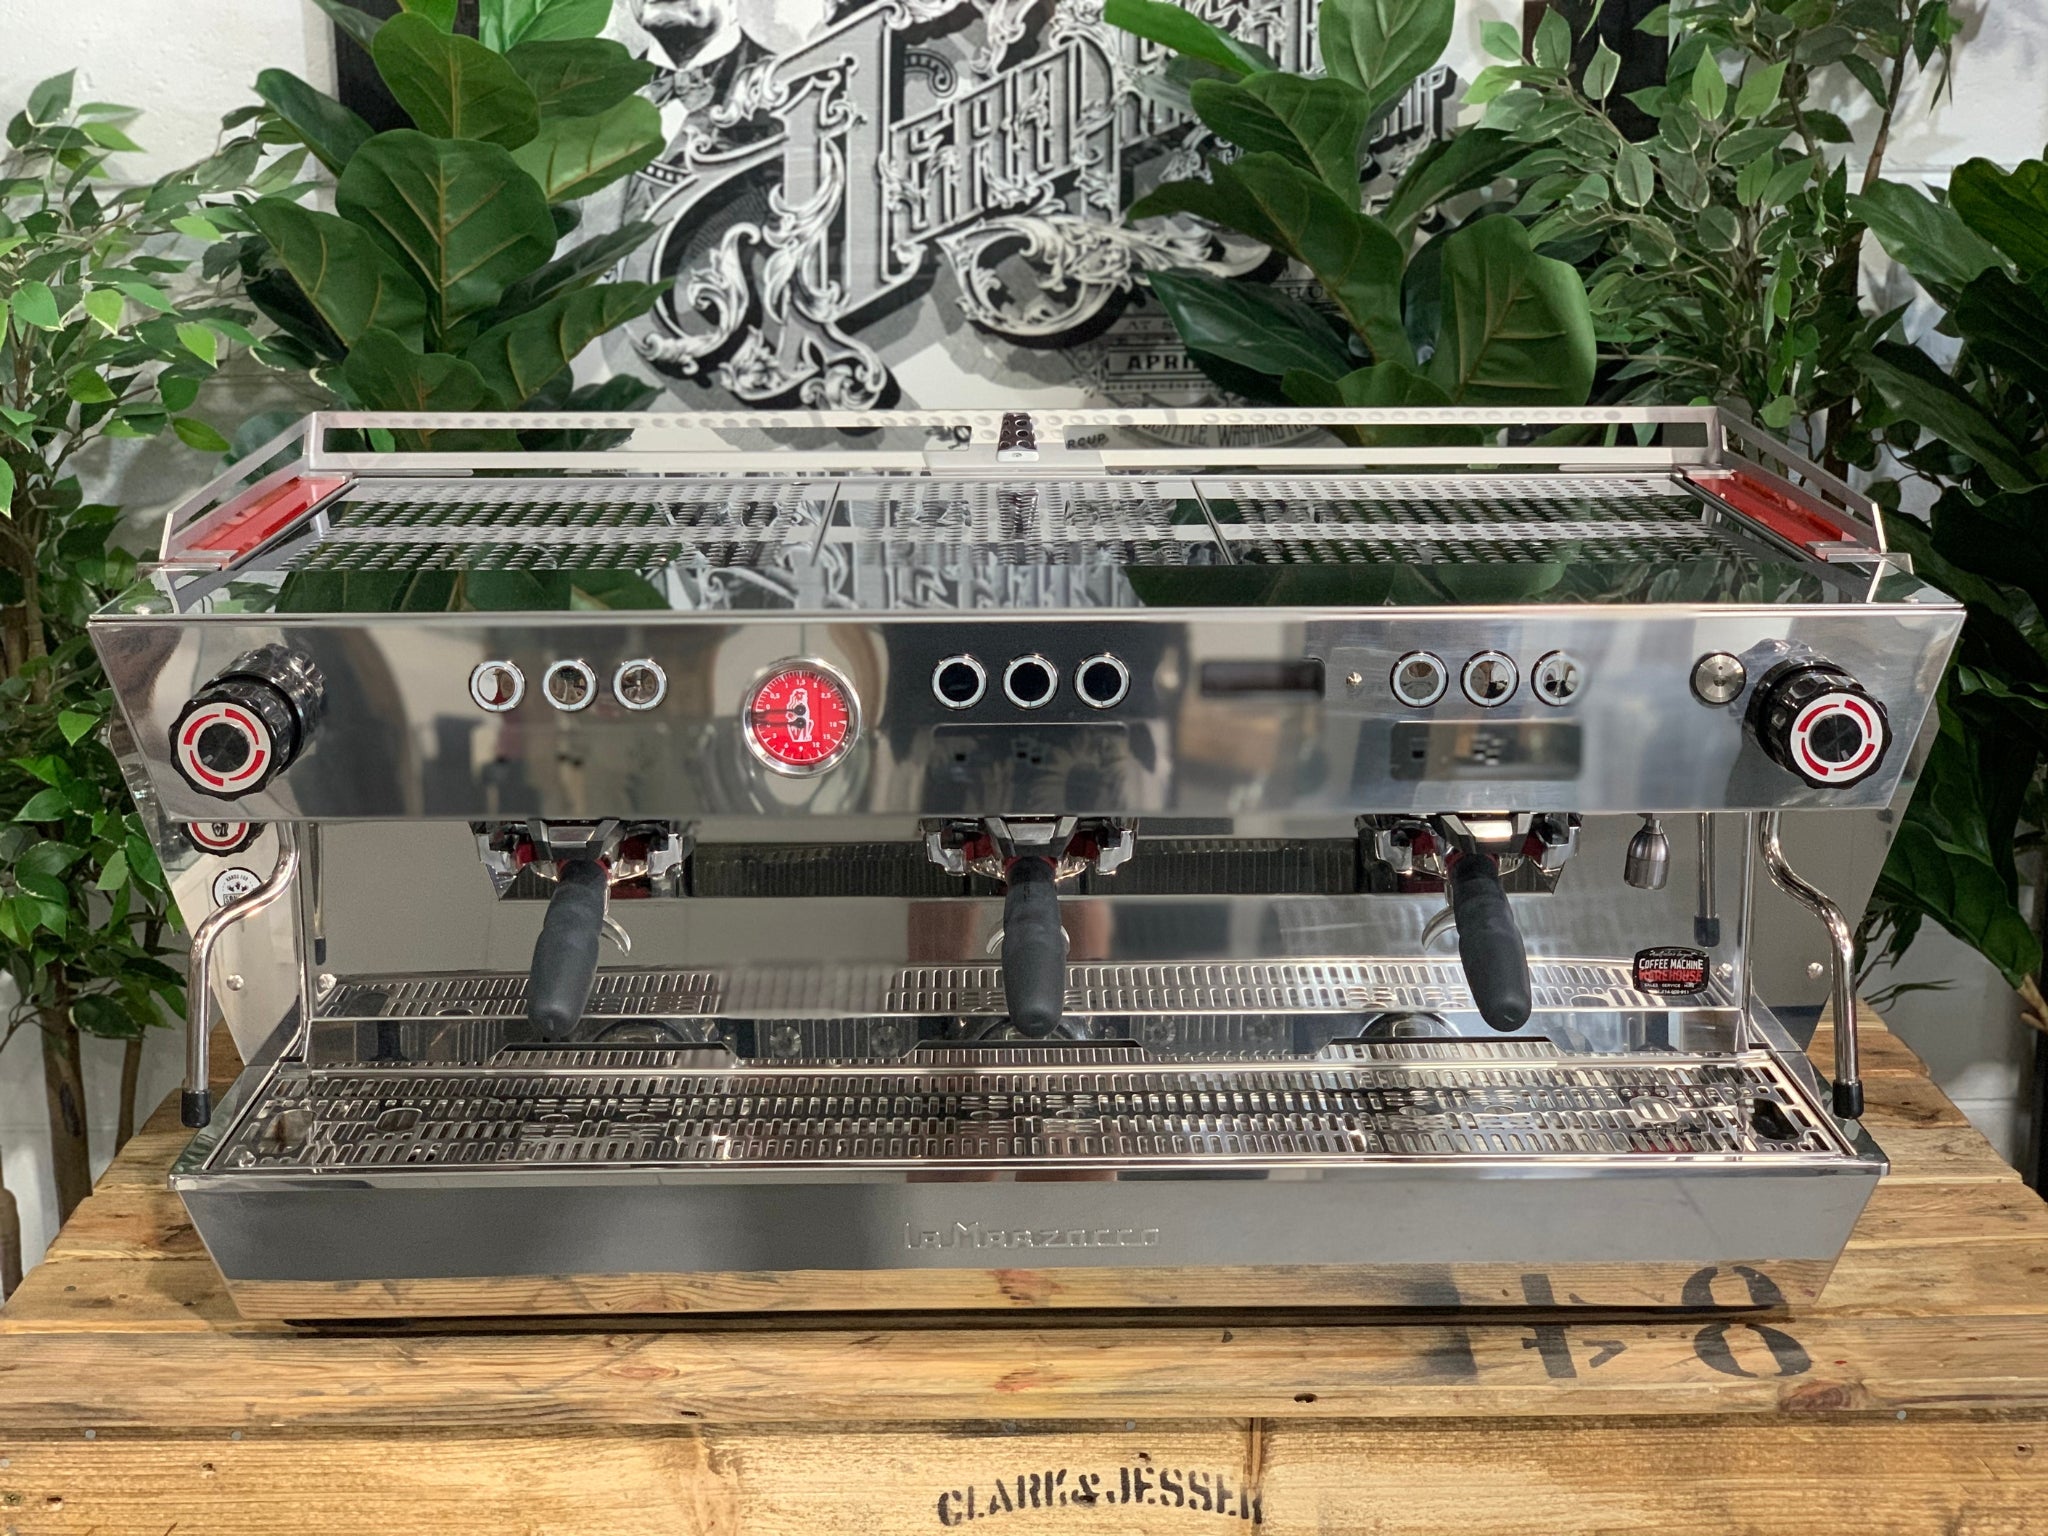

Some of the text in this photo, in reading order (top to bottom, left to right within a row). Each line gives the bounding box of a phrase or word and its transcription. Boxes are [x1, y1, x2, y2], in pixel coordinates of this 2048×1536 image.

[1127, 354, 1190, 371] APRI
[1638, 958, 1704, 970] COFFEE MACHINE
